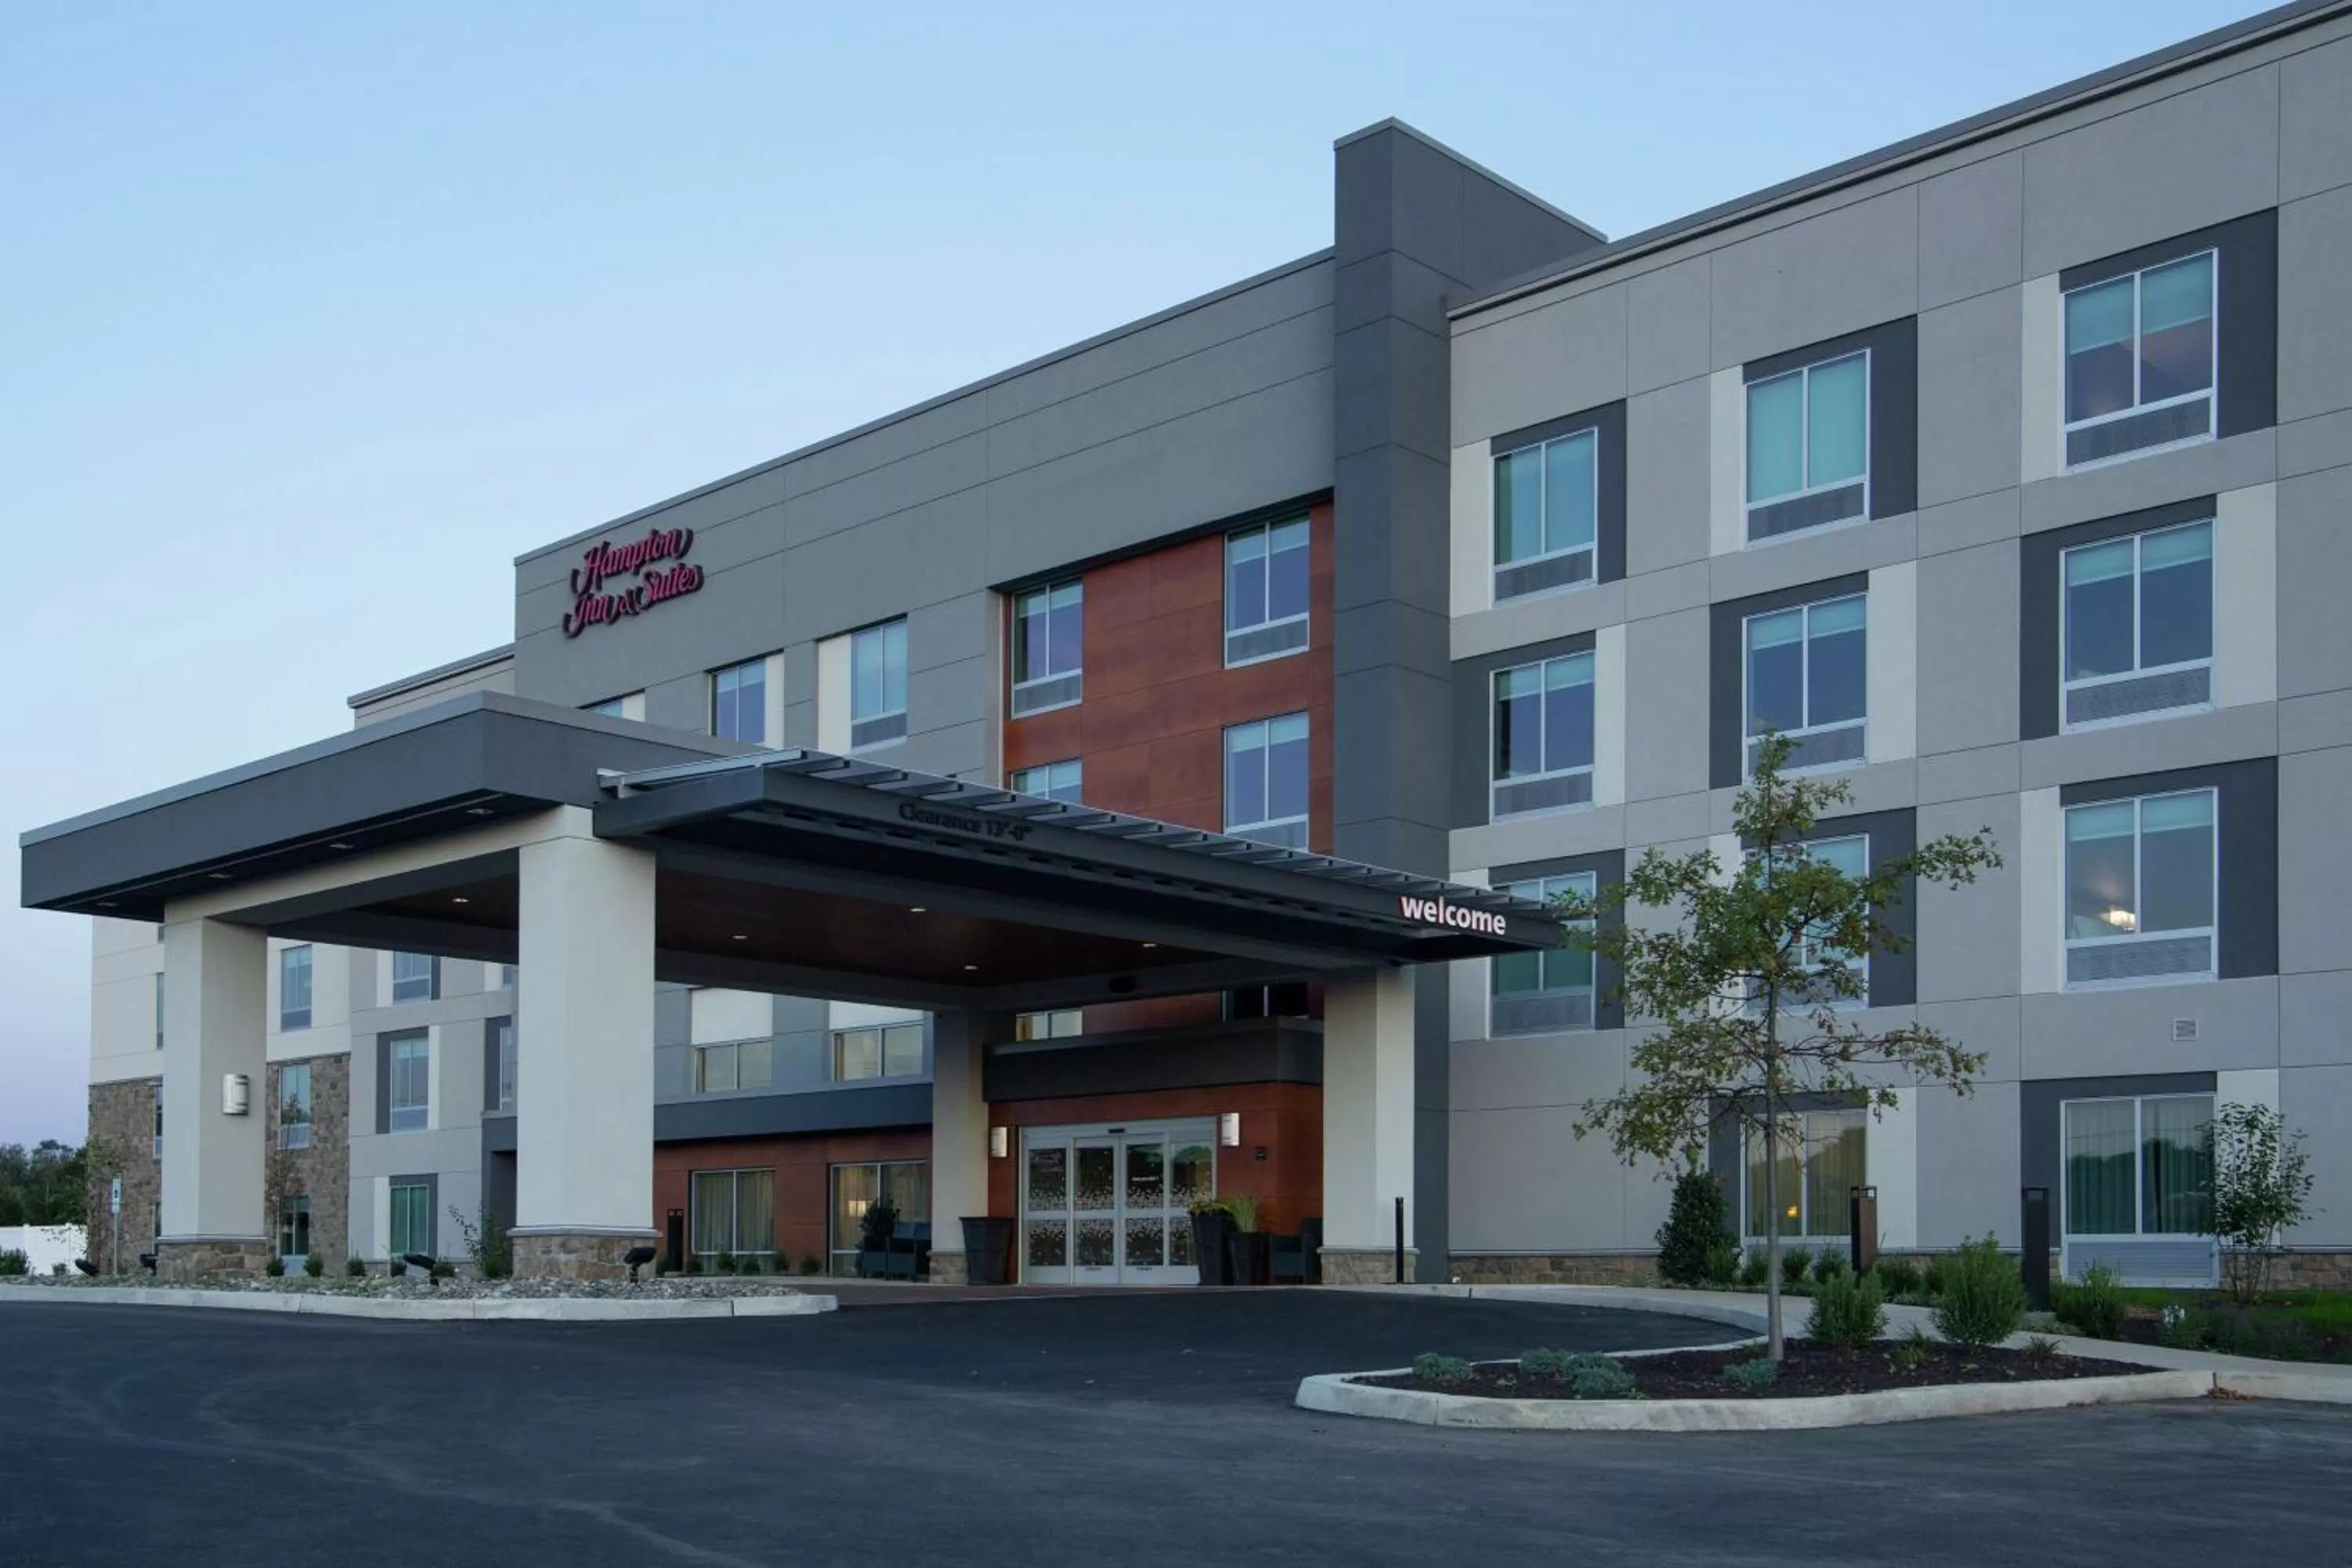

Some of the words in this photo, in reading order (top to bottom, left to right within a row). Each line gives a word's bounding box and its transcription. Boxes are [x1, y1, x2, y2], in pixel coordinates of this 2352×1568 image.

[571, 528, 693, 595] Hampton
[563, 593, 620, 638] Inn
[636, 563, 704, 611] Suites
[899, 803, 981, 833] Clearance
[1399, 896, 1506, 935] welcome
